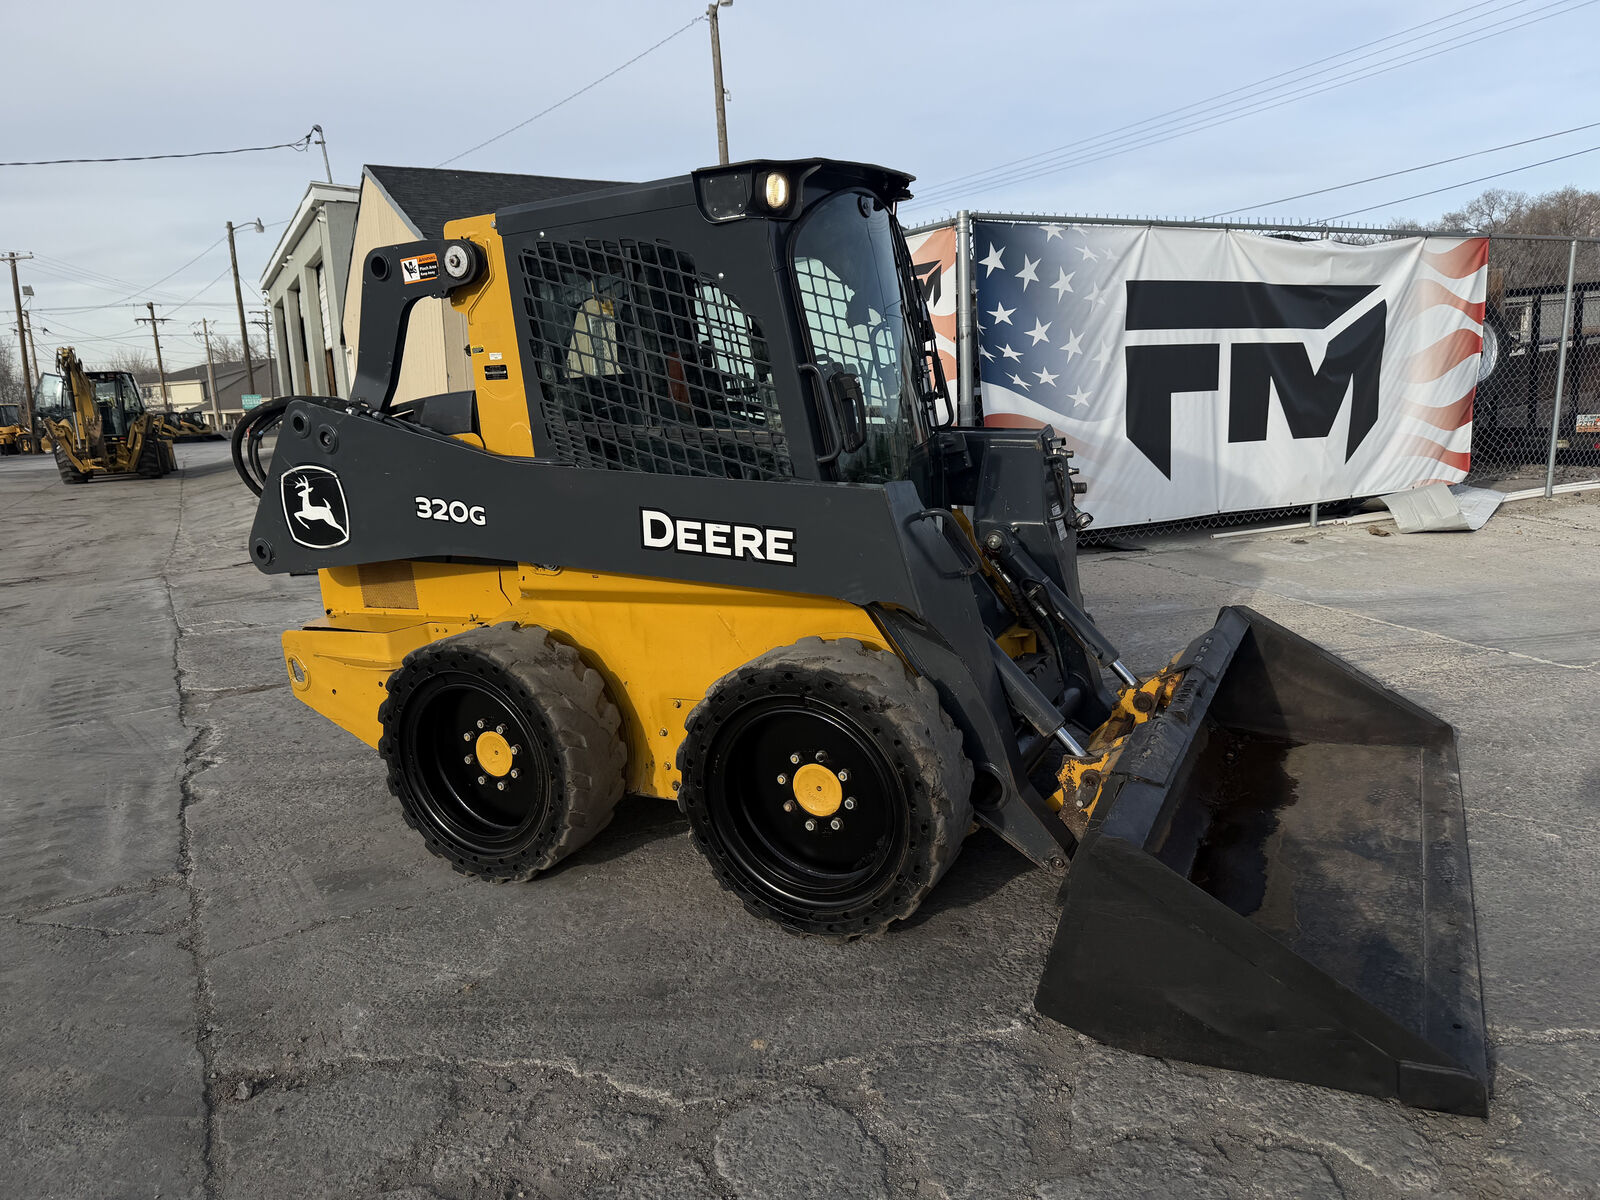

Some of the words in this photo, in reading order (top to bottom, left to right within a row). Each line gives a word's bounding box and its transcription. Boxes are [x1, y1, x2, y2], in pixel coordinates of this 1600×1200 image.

[1125, 279, 1387, 480] FM
[415, 496, 487, 526] 320G
[641, 509, 794, 563] DEERE
